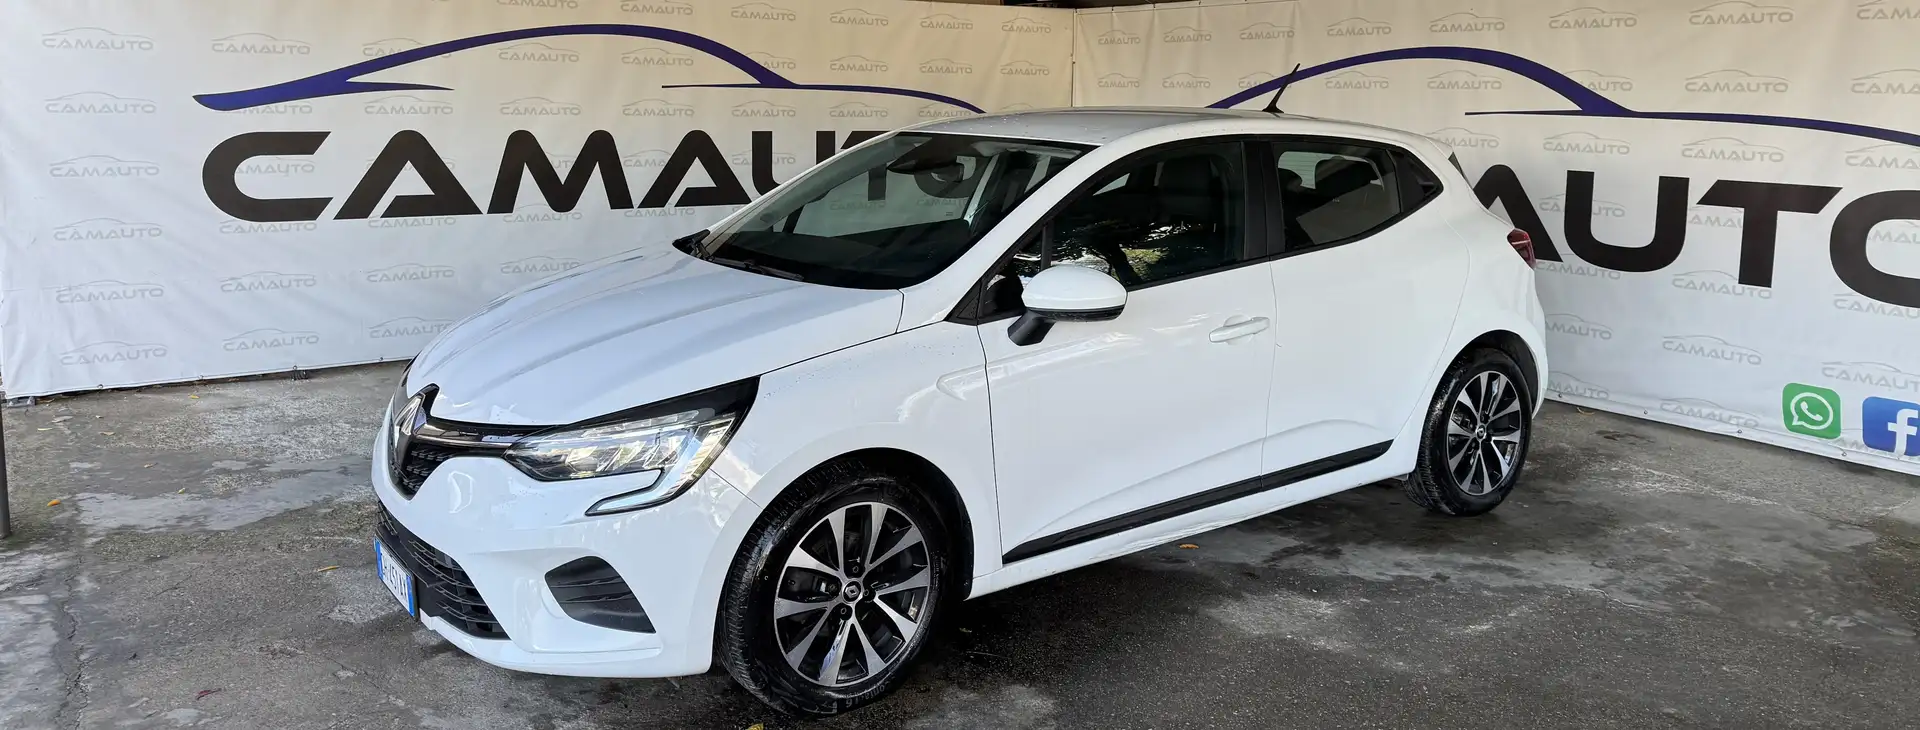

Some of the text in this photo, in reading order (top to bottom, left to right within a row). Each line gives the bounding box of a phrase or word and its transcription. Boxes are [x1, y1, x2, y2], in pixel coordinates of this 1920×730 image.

[620, 3, 694, 15] CAMAUTO
[731, 10, 796, 22] CAMAUTO
[830, 15, 889, 27] CAMAUTO
[1549, 15, 1637, 30] CAMAUTO
[1689, 9, 1794, 26] CAMAUTO
[921, 20, 973, 30] CAMAUTO
[1002, 24, 1051, 34] CAMAUTO
[1327, 24, 1392, 37] CAMAUTO
[1429, 20, 1505, 34] CAMAUTO
[1098, 36, 1141, 46] CAMAUTO
[1163, 32, 1212, 43] CAMAUTO
[1239, 28, 1295, 41] CAMAUTO
[42, 37, 154, 51] CAMAUTO
[211, 42, 311, 56] CAMAUTO
[498, 51, 579, 63] CAMAUTO
[621, 55, 694, 67] CAMAUTO
[830, 62, 889, 73] CAMAUTO
[919, 65, 973, 75] CAMAUTO
[1000, 67, 1050, 76] CAMAUTO
[1098, 79, 1140, 89] CAMAUTO
[1162, 79, 1211, 89] CAMAUTO
[1325, 79, 1389, 90] CAMAUTO
[1427, 79, 1502, 91] CAMAUTO
[1684, 77, 1789, 94] CAMAUTO
[45, 101, 157, 116] CAMAUTO
[364, 104, 453, 116] CAMAUTO
[499, 105, 581, 117] CAMAUTO
[622, 106, 695, 118] CAMAUTO
[732, 107, 796, 119] CAMAUTO
[829, 108, 888, 119] CAMAUTO
[1543, 140, 1630, 155] CAMAUTO
[1681, 145, 1785, 163] CAMAUTO
[50, 163, 160, 178] CAMAUTO
[503, 210, 583, 223] CAMAUTO
[624, 207, 696, 218] CAMAUTO
[219, 221, 317, 235] CAMAUTO
[368, 216, 456, 229] CAMAUTO
[53, 226, 163, 242] CAMAUTO
[366, 268, 455, 283] CAMAUTO
[220, 275, 317, 293] CAMAUTO
[1672, 275, 1772, 299] CAMAUTO
[56, 286, 165, 304] CAMAUTO
[223, 334, 319, 353] CAMAUTO
[60, 346, 169, 367] CAMAUTO
[1662, 339, 1762, 366] CAMAUTO
